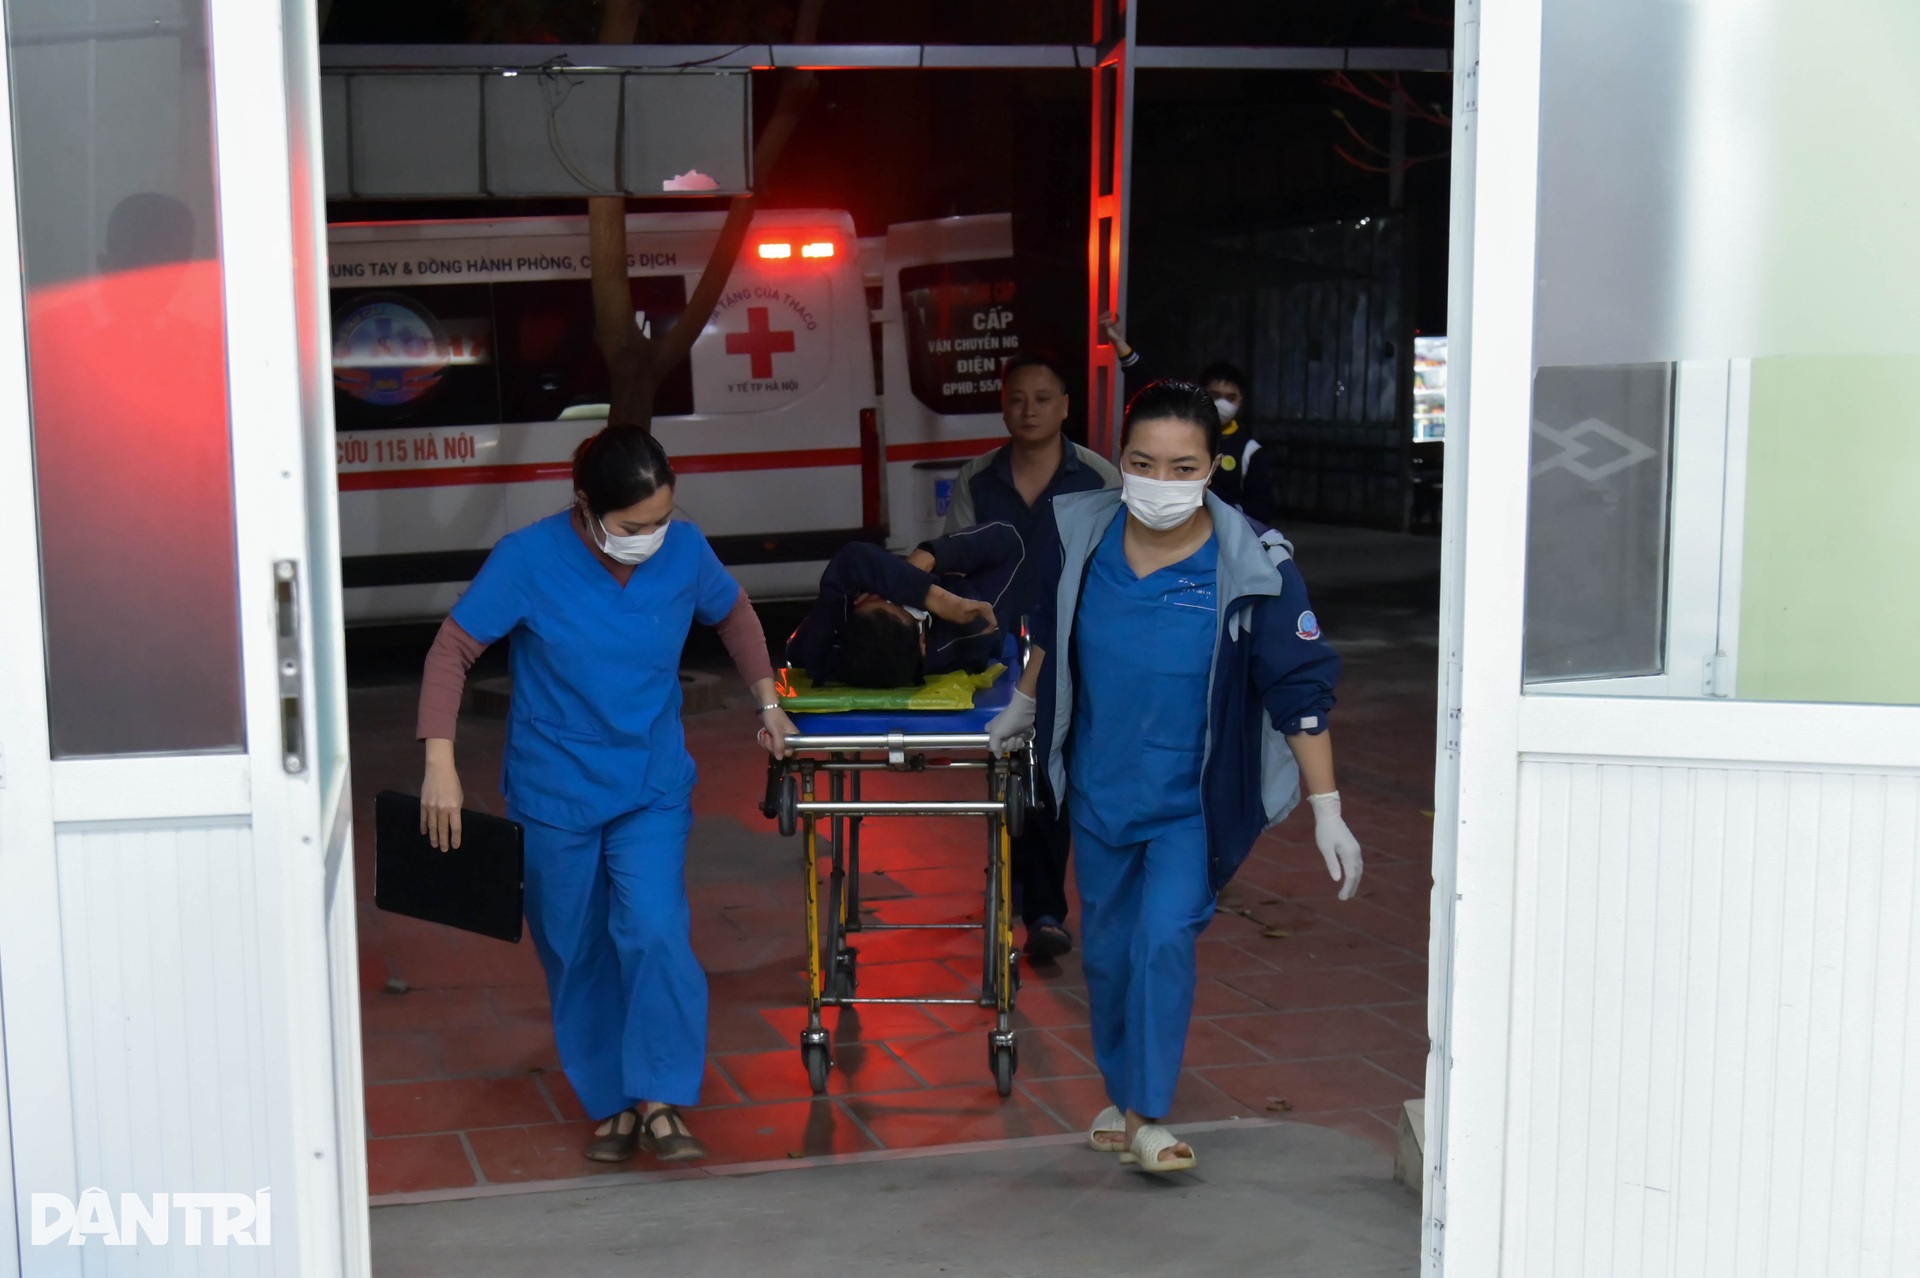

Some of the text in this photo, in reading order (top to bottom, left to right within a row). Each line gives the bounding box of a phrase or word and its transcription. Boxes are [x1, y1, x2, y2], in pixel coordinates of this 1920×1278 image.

[330, 263, 365, 278] UNG
[368, 262, 398, 276] TAY
[403, 262, 412, 275] &
[418, 258, 462, 274] ĐỒNG
[467, 256, 512, 272] HÀNH
[517, 254, 576, 272] PHÒNG,
[640, 253, 677, 269] DỊCH
[754, 284, 780, 300] CỦA
[783, 293, 817, 331] THACO
[973, 306, 1014, 330] CẤP
[1002, 336, 1018, 348] NG
[727, 383, 734, 393] Y
[751, 383, 763, 392] TP
[765, 380, 779, 392] HÀ
[375, 440, 408, 463] 115
[413, 432, 438, 461] HÀ
[444, 432, 475, 463] NỘI
